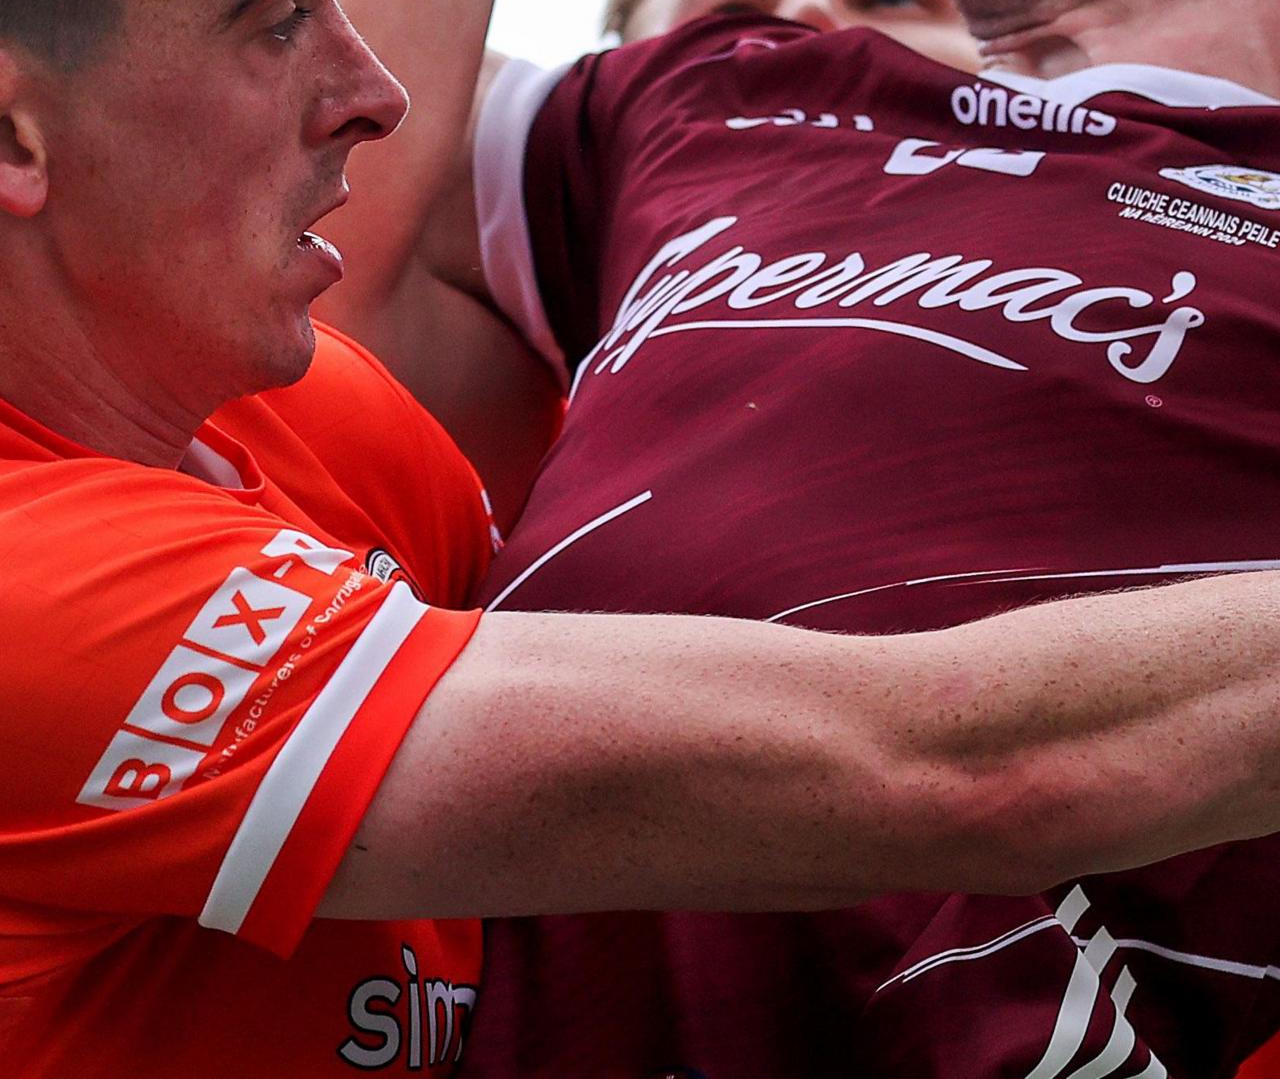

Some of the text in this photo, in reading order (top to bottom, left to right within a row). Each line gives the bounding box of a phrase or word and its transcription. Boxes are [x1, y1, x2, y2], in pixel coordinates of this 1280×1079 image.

[1107, 182, 1169, 213] CLUICHE
[1167, 198, 1240, 238] CEANNAIS
[1118, 206, 1143, 221] NA
[569, 216, 1205, 384] Supermac's
